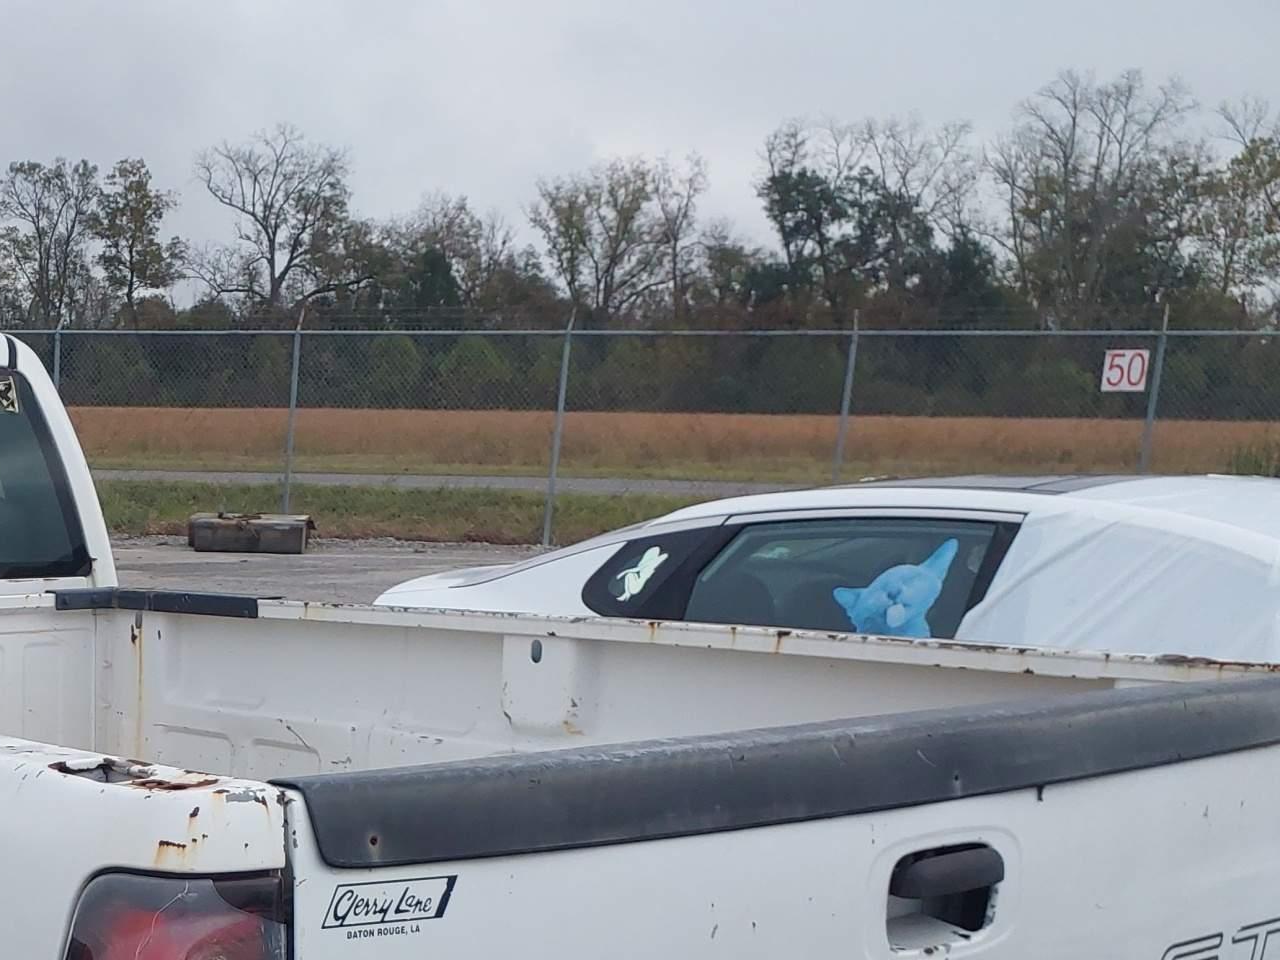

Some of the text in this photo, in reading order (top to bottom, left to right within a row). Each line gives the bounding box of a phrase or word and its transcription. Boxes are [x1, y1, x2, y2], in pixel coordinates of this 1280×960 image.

[1106, 352, 1146, 387] 50
[333, 886, 433, 927] Gerry Lane
[346, 924, 421, 940] BATON ROUGE, LA
